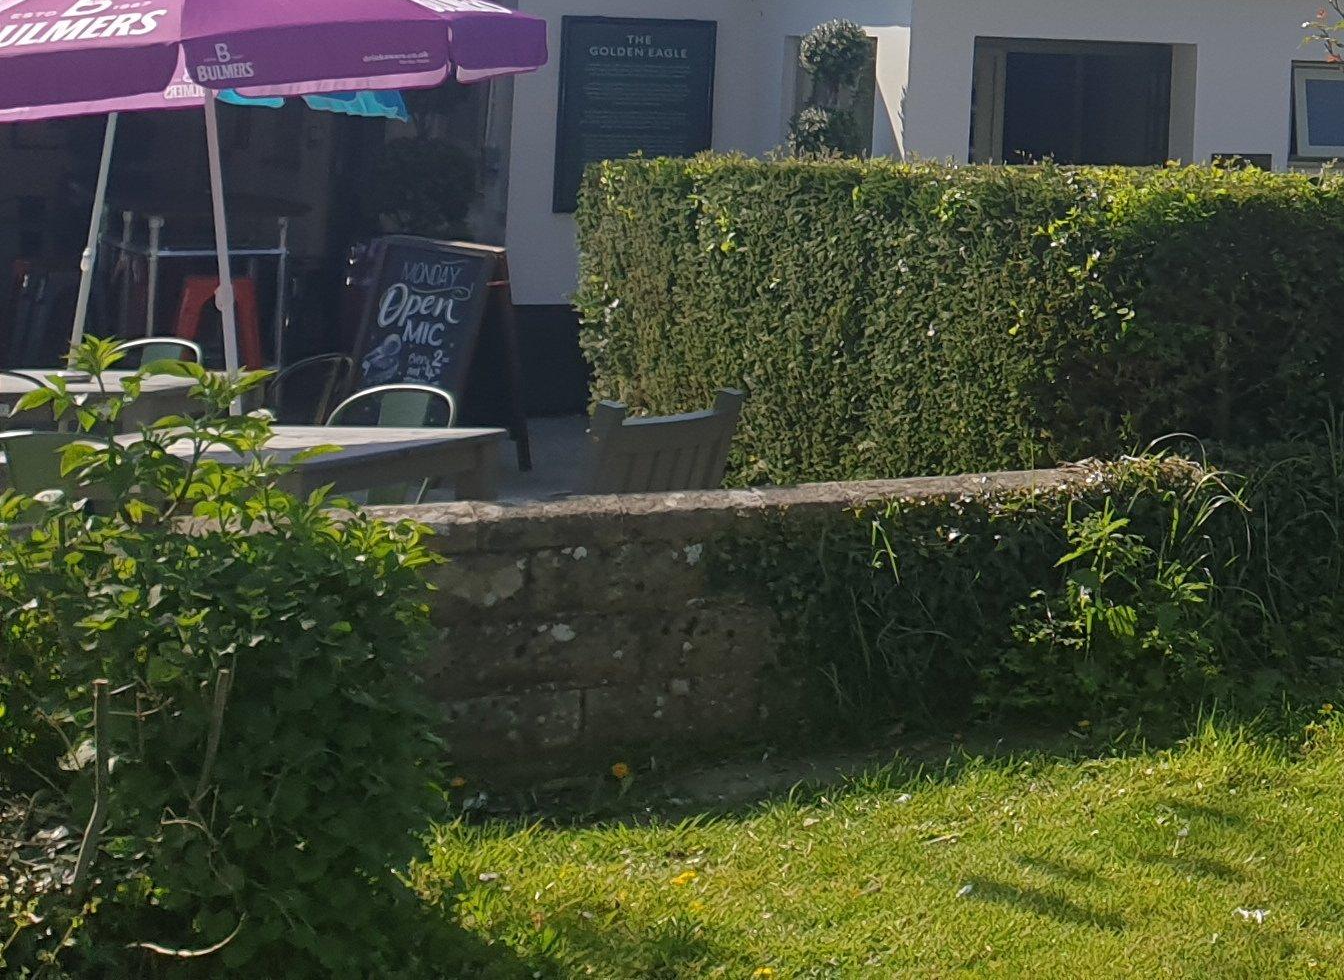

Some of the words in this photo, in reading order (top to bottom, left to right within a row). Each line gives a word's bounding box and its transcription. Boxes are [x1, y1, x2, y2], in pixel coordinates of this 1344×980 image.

[0, 9, 168, 47] ULMERS
[627, 34, 652, 44] THE
[589, 46, 644, 57] GOLDEN
[649, 47, 688, 58] EAGLE
[196, 61, 254, 82] BULMERS
[402, 261, 462, 286] MONDAY
[377, 282, 460, 328] Open
[402, 319, 446, 347] MIC
